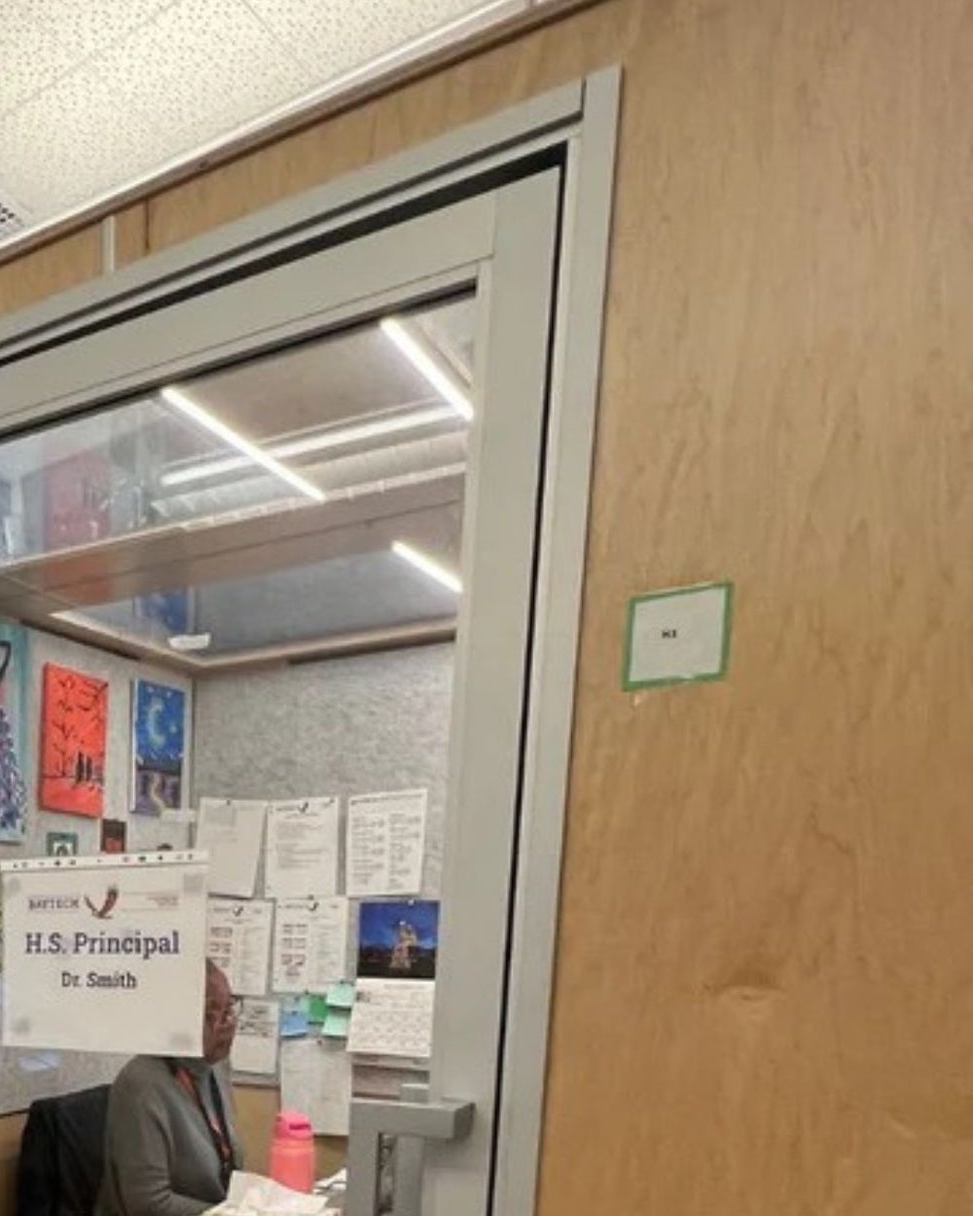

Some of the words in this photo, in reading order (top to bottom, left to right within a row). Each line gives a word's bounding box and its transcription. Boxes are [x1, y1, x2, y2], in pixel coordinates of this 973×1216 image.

[25, 932, 65, 955] H.S.
[73, 930, 180, 959] Principal
[61, 971, 80, 987] Dr.
[85, 971, 137, 989] Smith
